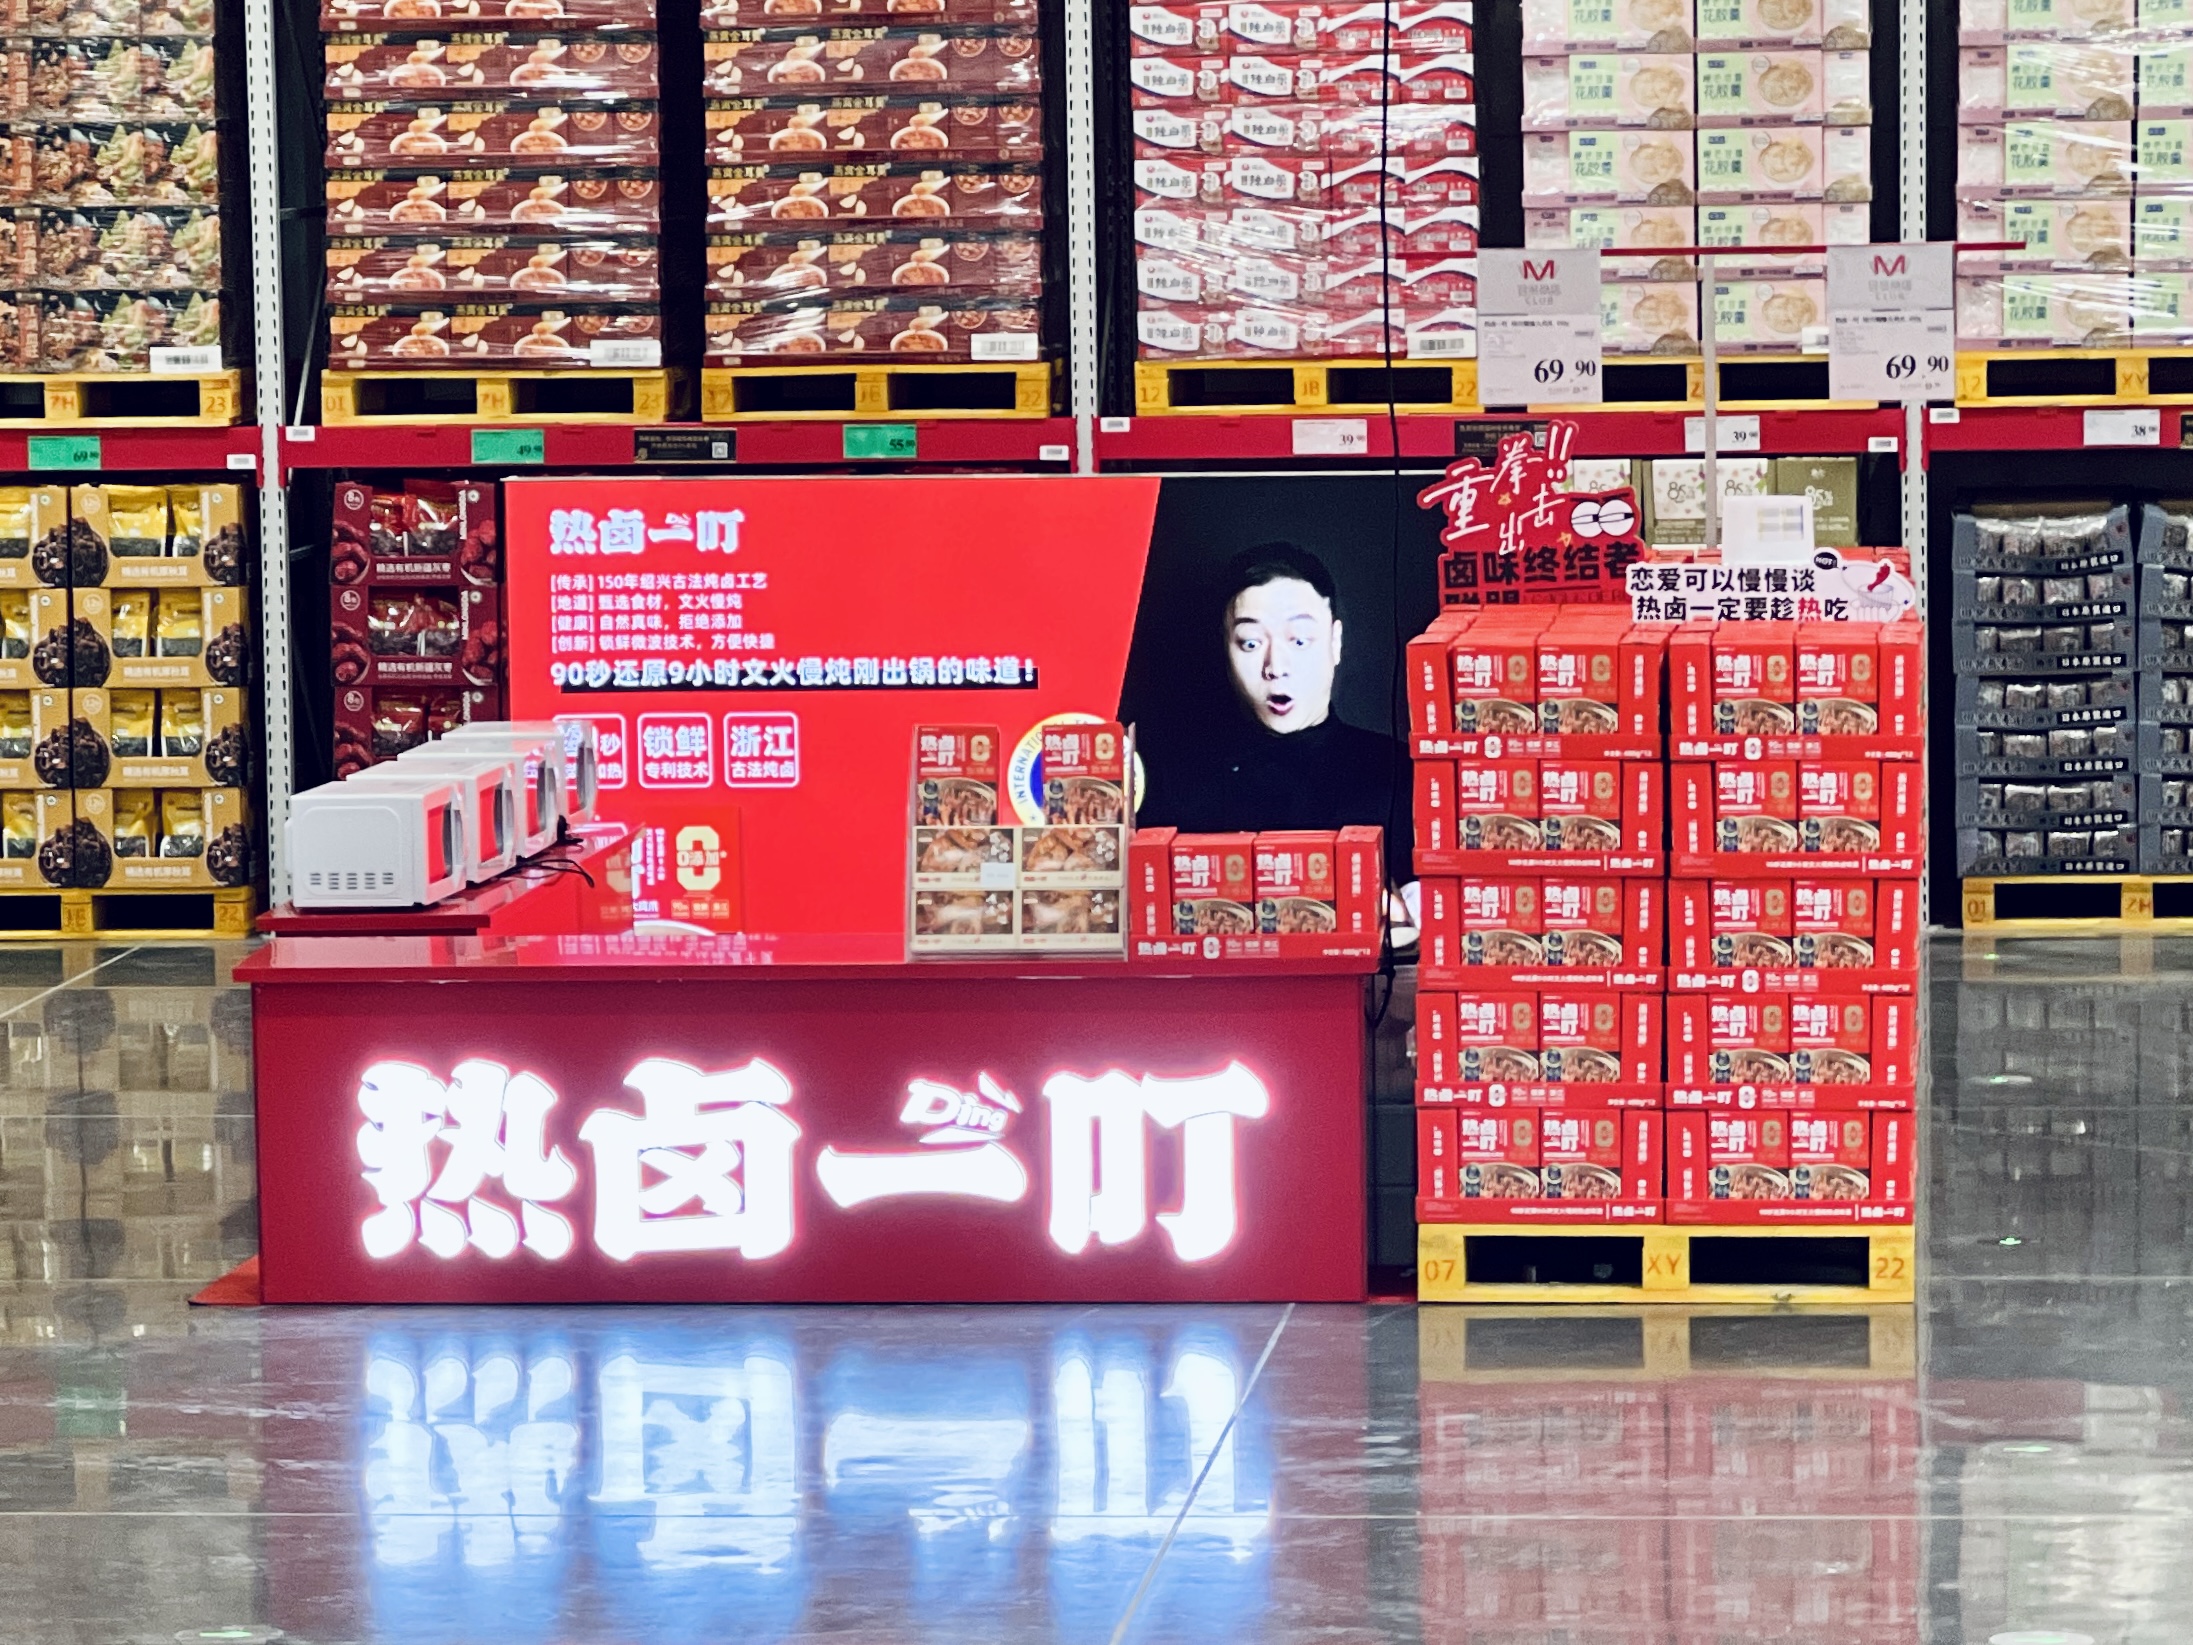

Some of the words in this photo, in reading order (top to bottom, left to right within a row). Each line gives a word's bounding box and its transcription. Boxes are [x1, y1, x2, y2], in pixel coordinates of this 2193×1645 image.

[550, 509, 746, 554] 热卤一叮
[1444, 542, 1640, 588] 卤味终结者
[1631, 567, 1815, 593] 恋爱可以慢慢谈
[1637, 597, 1849, 621] 热卤一定要趁热吃
[643, 725, 707, 758] 锁鲜
[730, 725, 795, 757] 浙江
[644, 761, 710, 779] 专利技术
[730, 760, 795, 779] 古法炖卤
[357, 1059, 1268, 1262] 热卤一叮
[1424, 1259, 1456, 1281] 07
[1647, 1255, 1681, 1276] XY
[1875, 1257, 1905, 1279] 22
